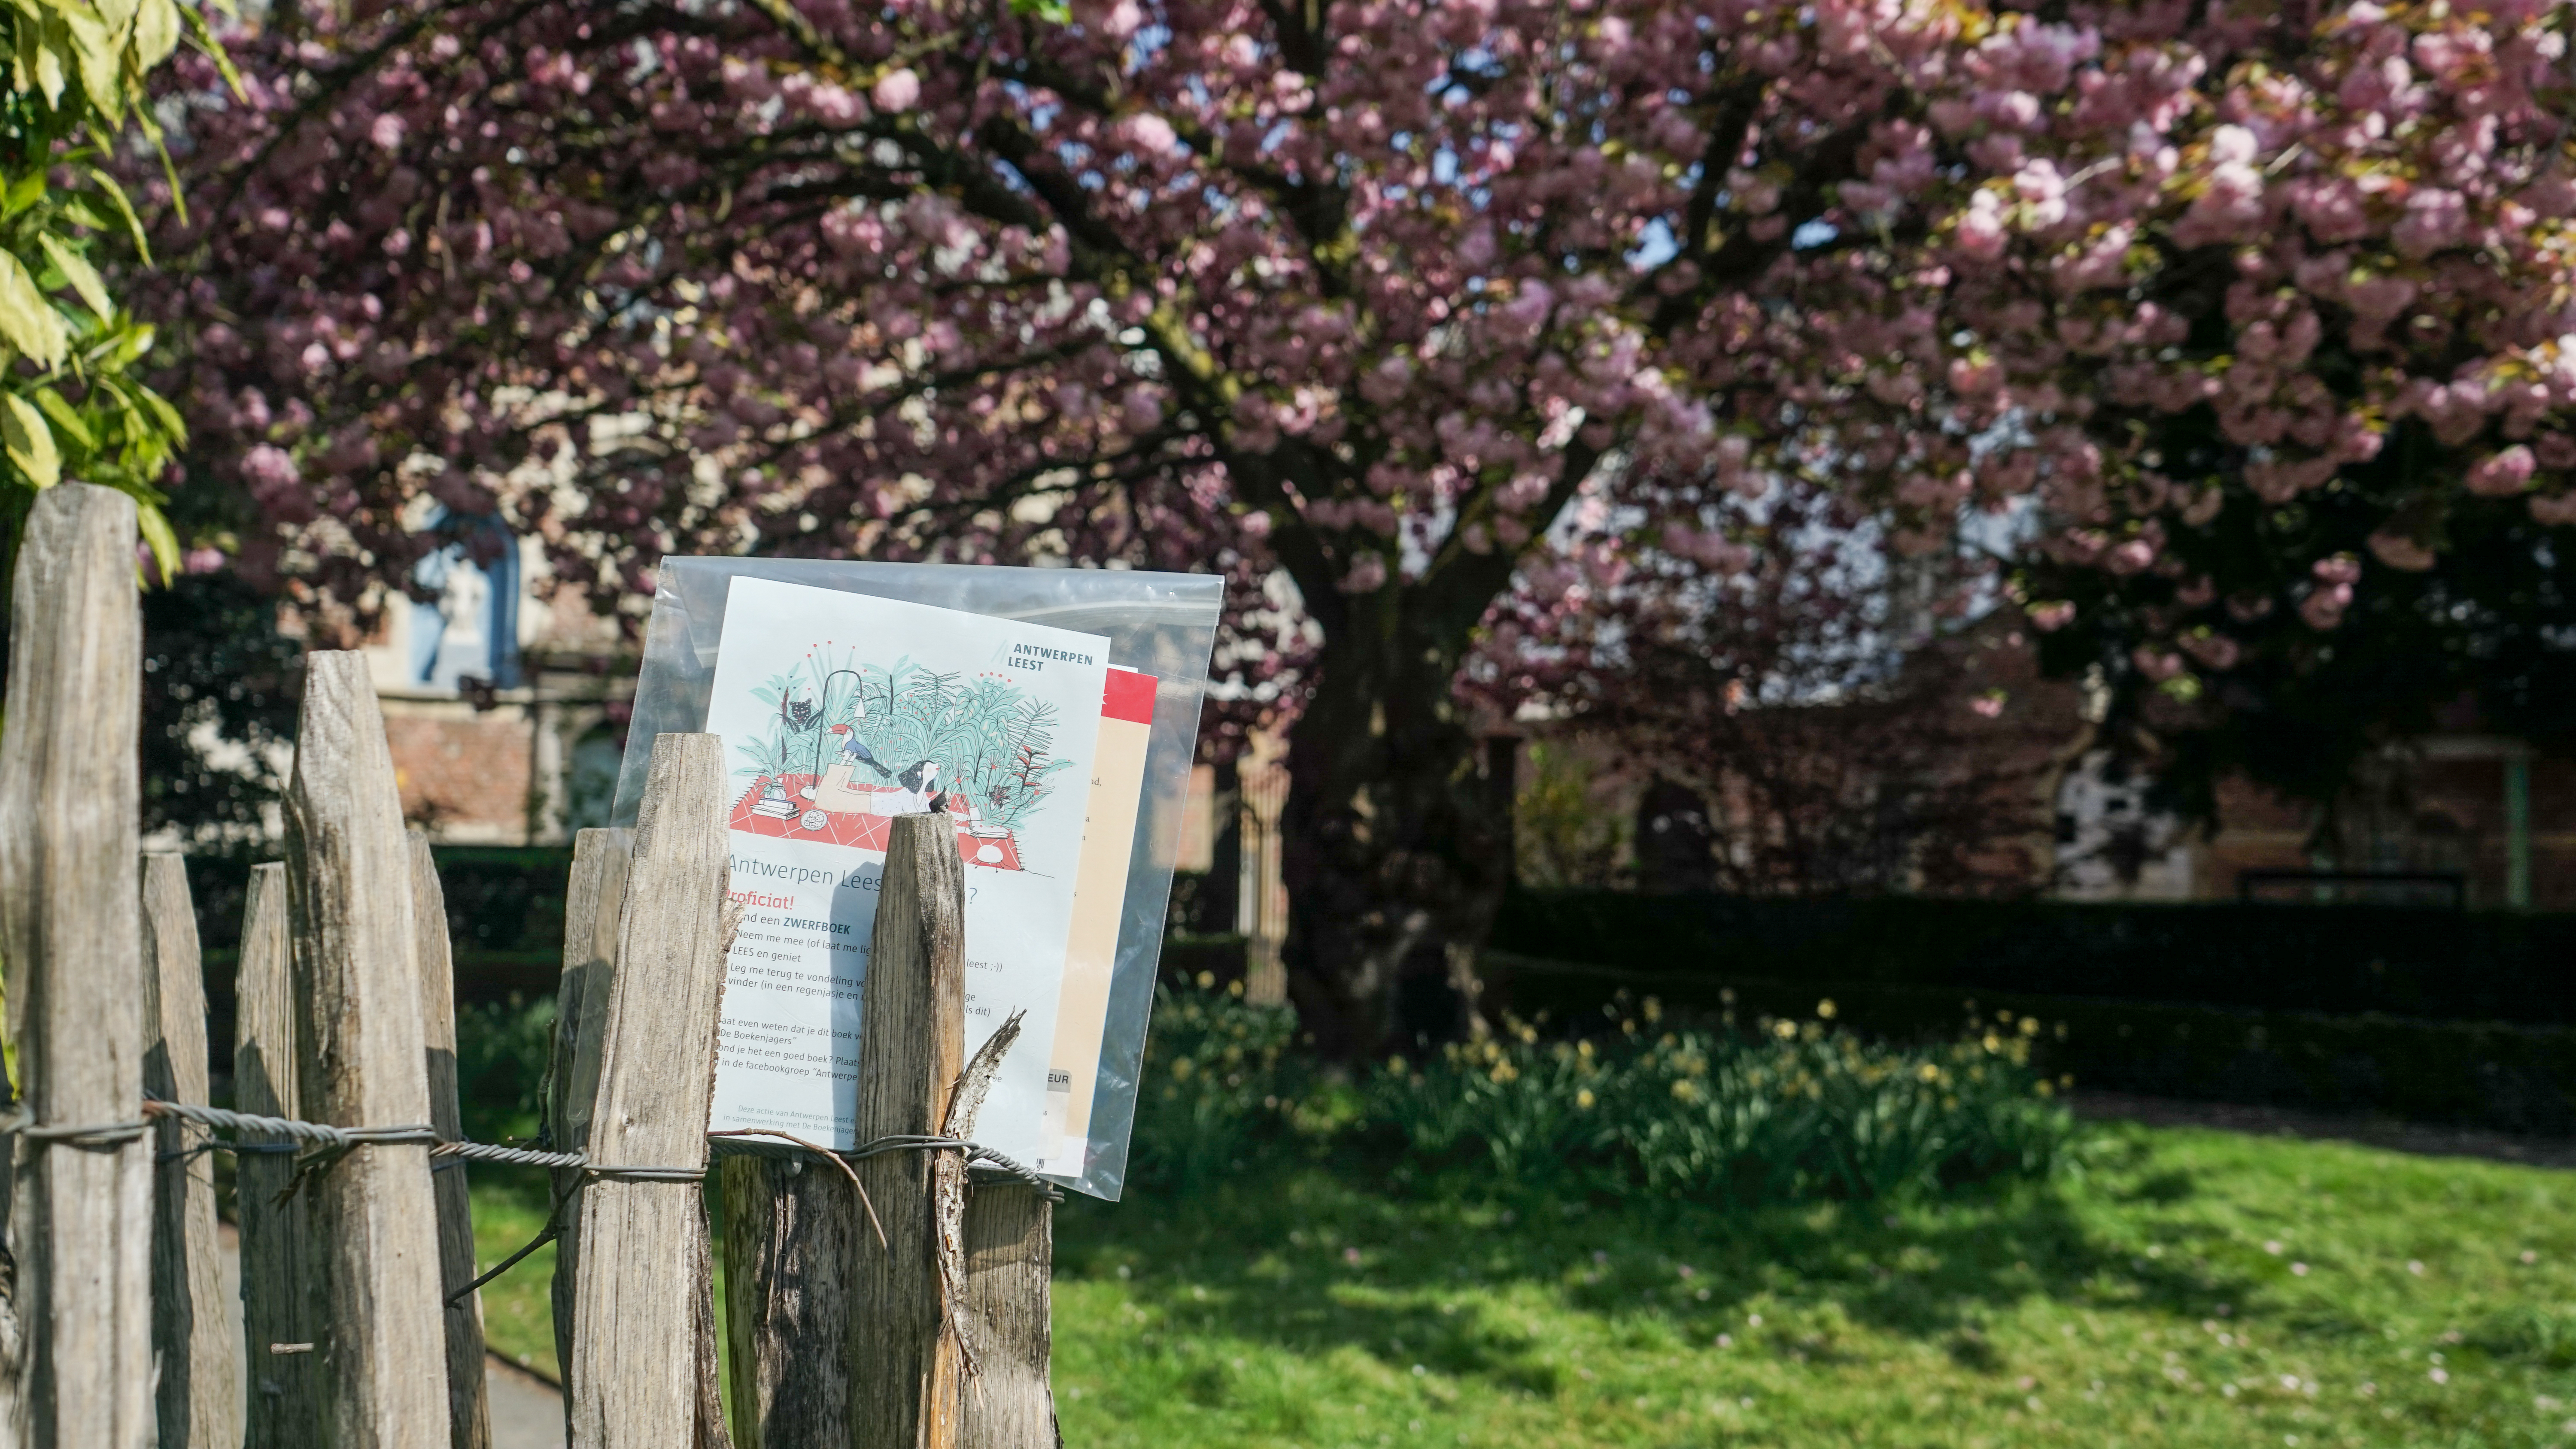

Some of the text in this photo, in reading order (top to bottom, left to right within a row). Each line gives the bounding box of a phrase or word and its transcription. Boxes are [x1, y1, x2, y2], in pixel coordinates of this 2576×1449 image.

[1008, 656, 1044, 671] LEEST
[1014, 643, 1093, 665] ANTWERPEN
[730, 854, 833, 885] Antwerpen
[743, 913, 851, 935] nd een ZWERFBOEK
[733, 946, 754, 956] LEES
[772, 952, 802, 962] geniet
[736, 930, 763, 940] Neem
[784, 937, 804, 946] mee
[807, 938, 820, 948] (of
[822, 940, 840, 951] laat
[843, 945, 857, 953] me
[966, 959, 987, 970] leest
[730, 963, 746, 974] Leg
[749, 967, 764, 975] me
[767, 968, 792, 980] terug
[795, 971, 804, 979] te
[807, 975, 853, 988] vondeling
[728, 977, 758, 988] vinder
[761, 980, 772, 990] (in
[776, 984, 793, 992] een
[796, 987, 844, 1000] regenjasje
[847, 992, 858, 1000] en
[975, 1006, 990, 1018] dit)
[762, 1022, 788, 1031] weten
[791, 1025, 805, 1034] dat
[807, 1027, 815, 1036] je
[818, 1028, 829, 1037] dit
[832, 1029, 852, 1040] boek
[737, 1045, 745, 1055] je
[748, 1046, 762, 1056] het
[783, 1052, 804, 1061] goed
[808, 1053, 833, 1064] boek?
[722, 1058, 729, 1066] in
[733, 1059, 743, 1068] de
[746, 1061, 809, 1076] facebookgroep
[732, 1116, 784, 1128] samenwerking
[738, 1105, 754, 1113] Deze
[790, 1111, 828, 1121] Antwerpen
[831, 1115, 848, 1123] Leest
